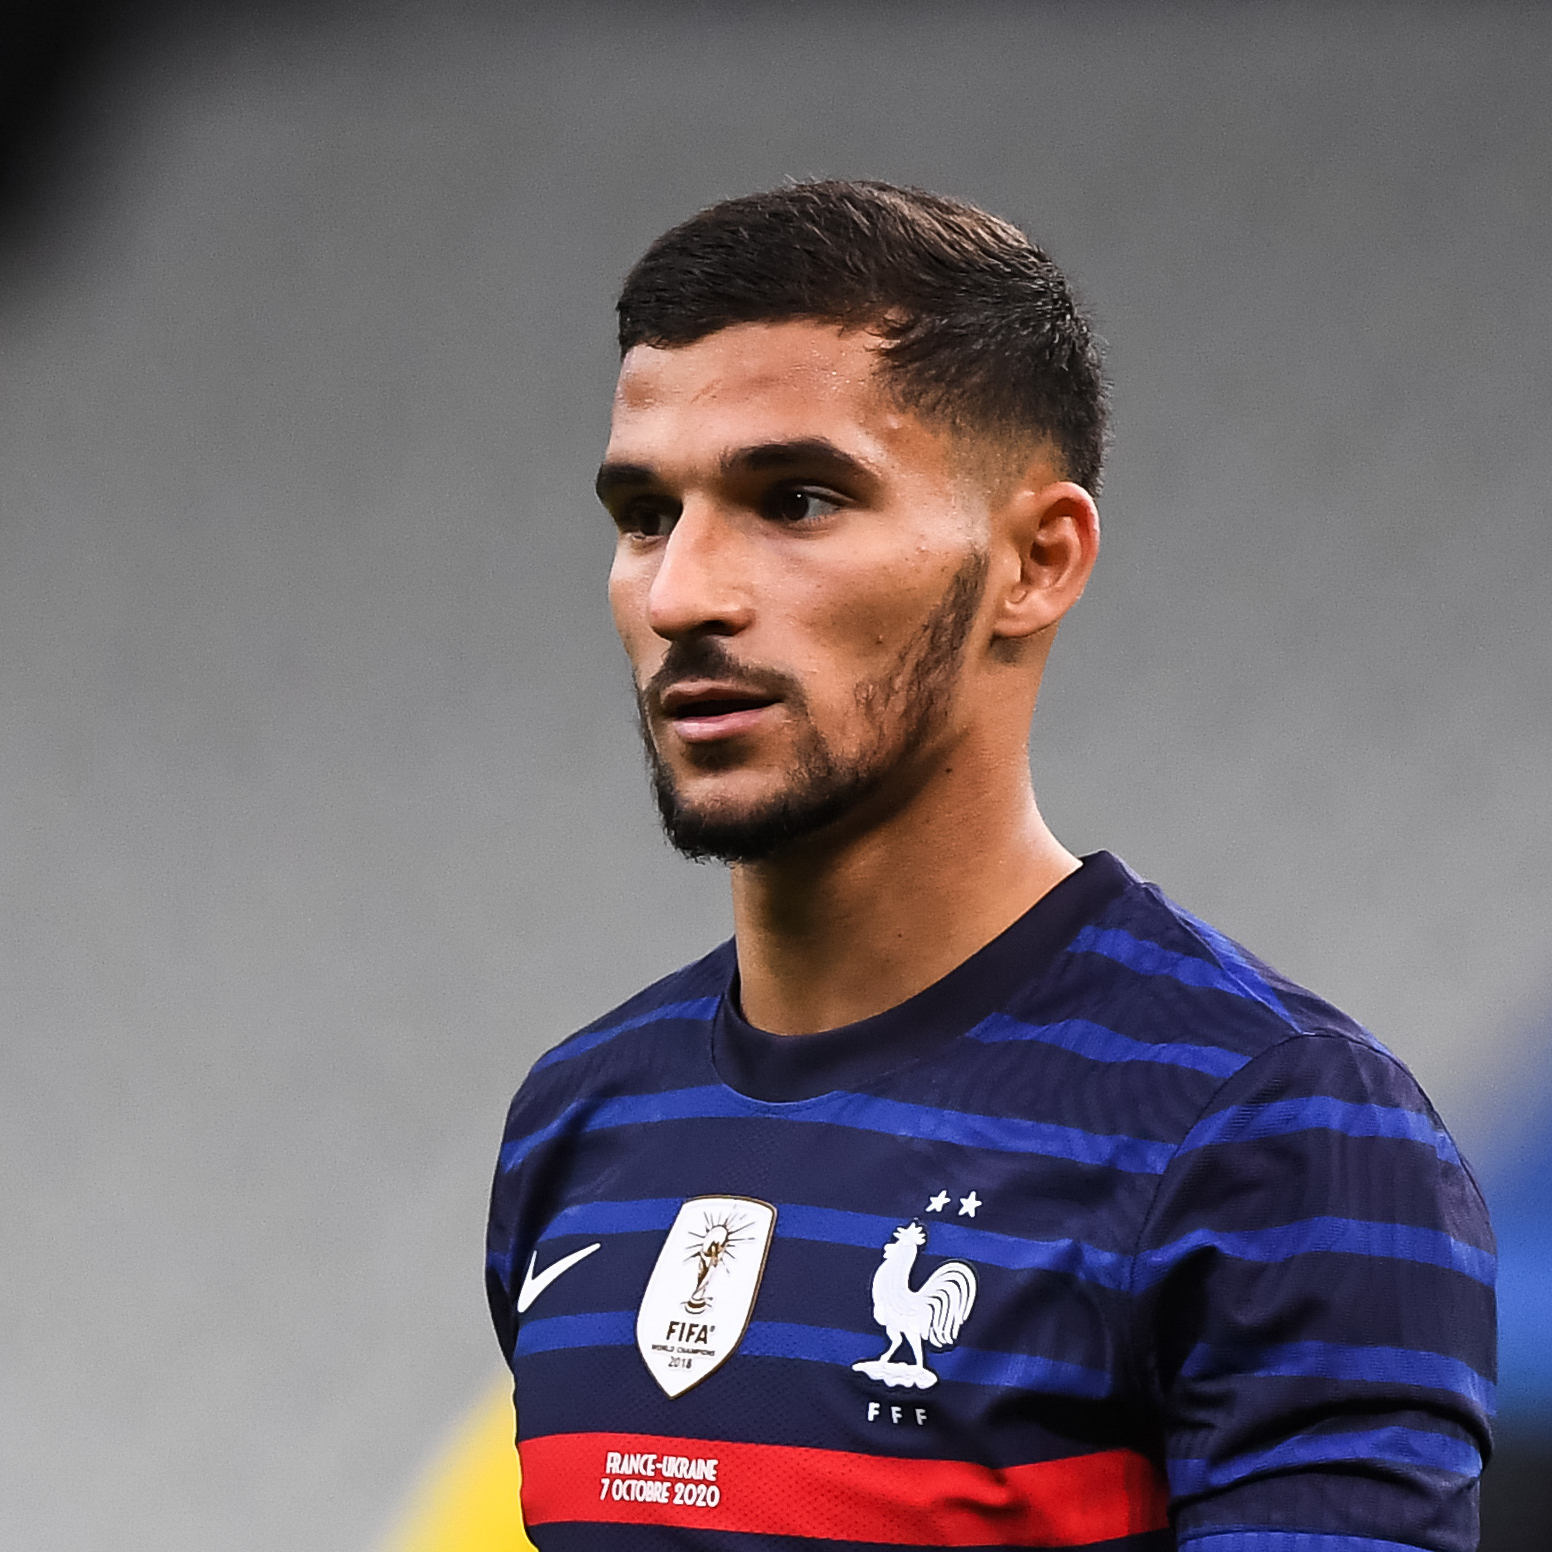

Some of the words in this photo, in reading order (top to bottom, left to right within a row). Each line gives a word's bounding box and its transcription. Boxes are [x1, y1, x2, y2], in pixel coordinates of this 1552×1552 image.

[665, 1320, 708, 1345] FIFA
[668, 1355, 693, 1369] 2018
[599, 1477, 611, 1501] 7
[611, 1478, 672, 1504] OCTOBRE
[672, 1481, 721, 1508] 2020
